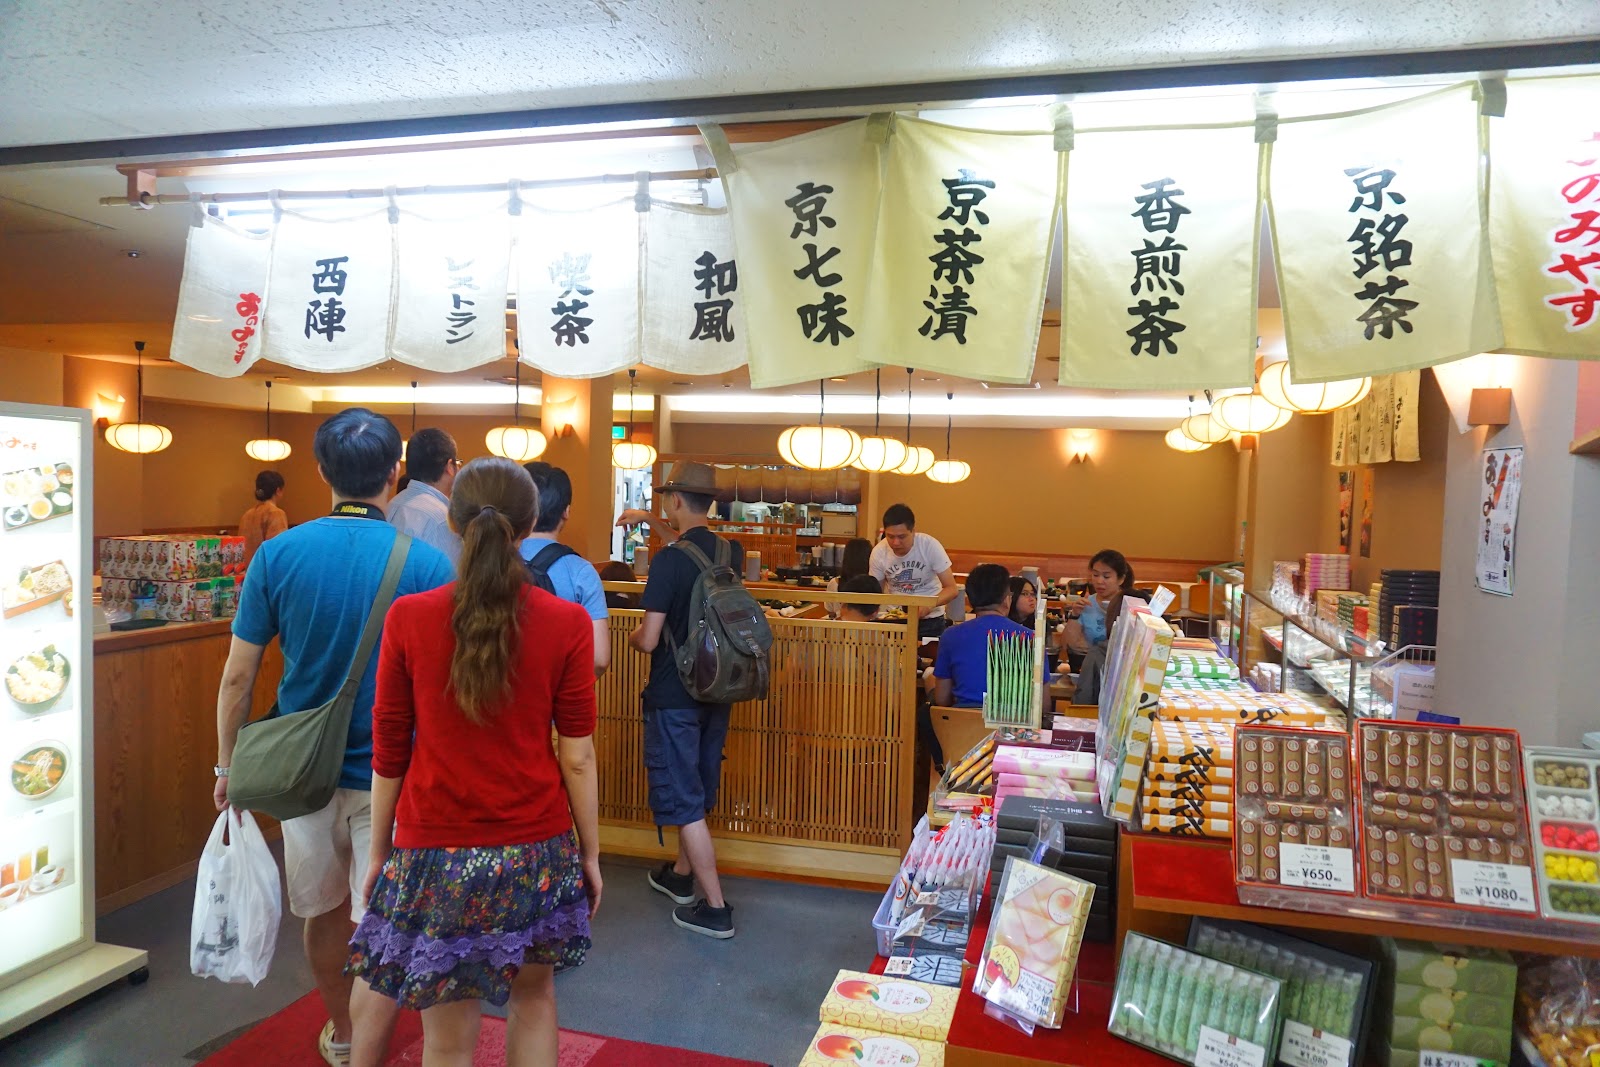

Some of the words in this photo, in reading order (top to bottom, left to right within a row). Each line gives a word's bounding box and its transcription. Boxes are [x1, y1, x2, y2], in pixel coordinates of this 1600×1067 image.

[784, 182, 855, 347] 京七味
[918, 168, 996, 344] 京茶漬
[1125, 176, 1192, 357] 香煎茶
[1343, 164, 1420, 340] 京銘茶
[1547, 131, 1600, 327] のみやす
[304, 255, 350, 343] 西陣
[444, 256, 480, 345] レストラン
[548, 252, 595, 347] 喫茶
[689, 251, 738, 344] 和風
[340, 505, 368, 515] Nikon
[1302, 868, 1333, 881] ¥650
[1475, 885, 1518, 900] ¥1080
